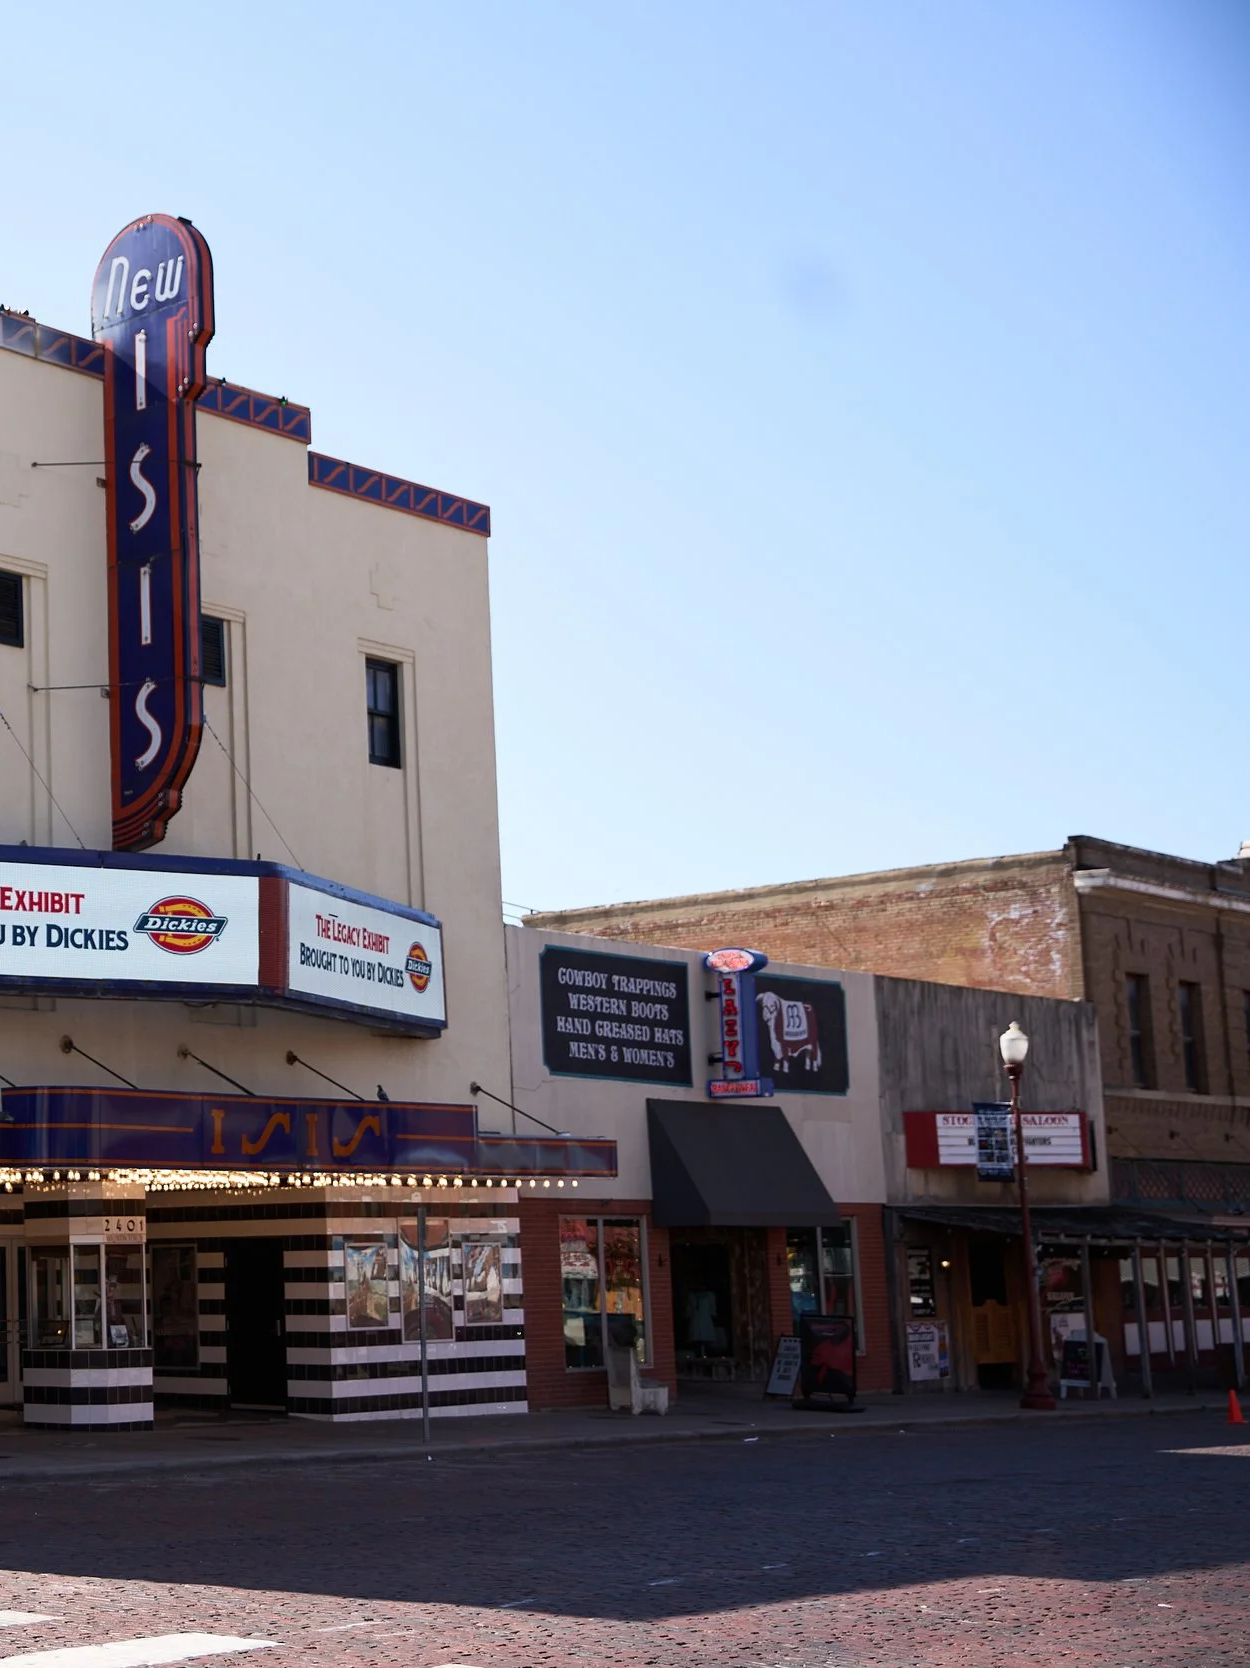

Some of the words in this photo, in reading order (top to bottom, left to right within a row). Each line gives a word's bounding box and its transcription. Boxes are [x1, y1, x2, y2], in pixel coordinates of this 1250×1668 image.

[129, 330, 159, 771] ISIS
[0, 886, 85, 914] EXHIBIT
[12, 924, 39, 947] BY
[46, 923, 129, 951] DICKIES
[143, 917, 218, 933] Dickies
[315, 914, 331, 939] THE
[332, 919, 361, 947] LEGACY
[362, 928, 390, 954] EXHIBIT
[300, 942, 337, 972] BROUGHT
[338, 955, 349, 975] TO
[350, 957, 365, 979] YOU
[367, 963, 376, 983] BY
[377, 962, 404, 988] DICKIES
[407, 960, 430, 974] Dickies
[558, 967, 608, 989] COWBOY
[612, 975, 676, 999] TRAPPINGS
[568, 993, 627, 1015] WESTERN
[631, 1001, 669, 1020] BOOTS
[722, 978, 739, 1057] LAZY
[556, 1016, 591, 1035] HAND
[595, 1020, 650, 1041] GREASED
[654, 1027, 684, 1045] HATS
[569, 1041, 606, 1061] MEN'S
[610, 1045, 619, 1062] &
[622, 1047, 675, 1068] WOMEN'S
[210, 1108, 380, 1157] ISIS
[1022, 1115, 1069, 1127] SALOON
[105, 1219, 145, 1232] 2401
